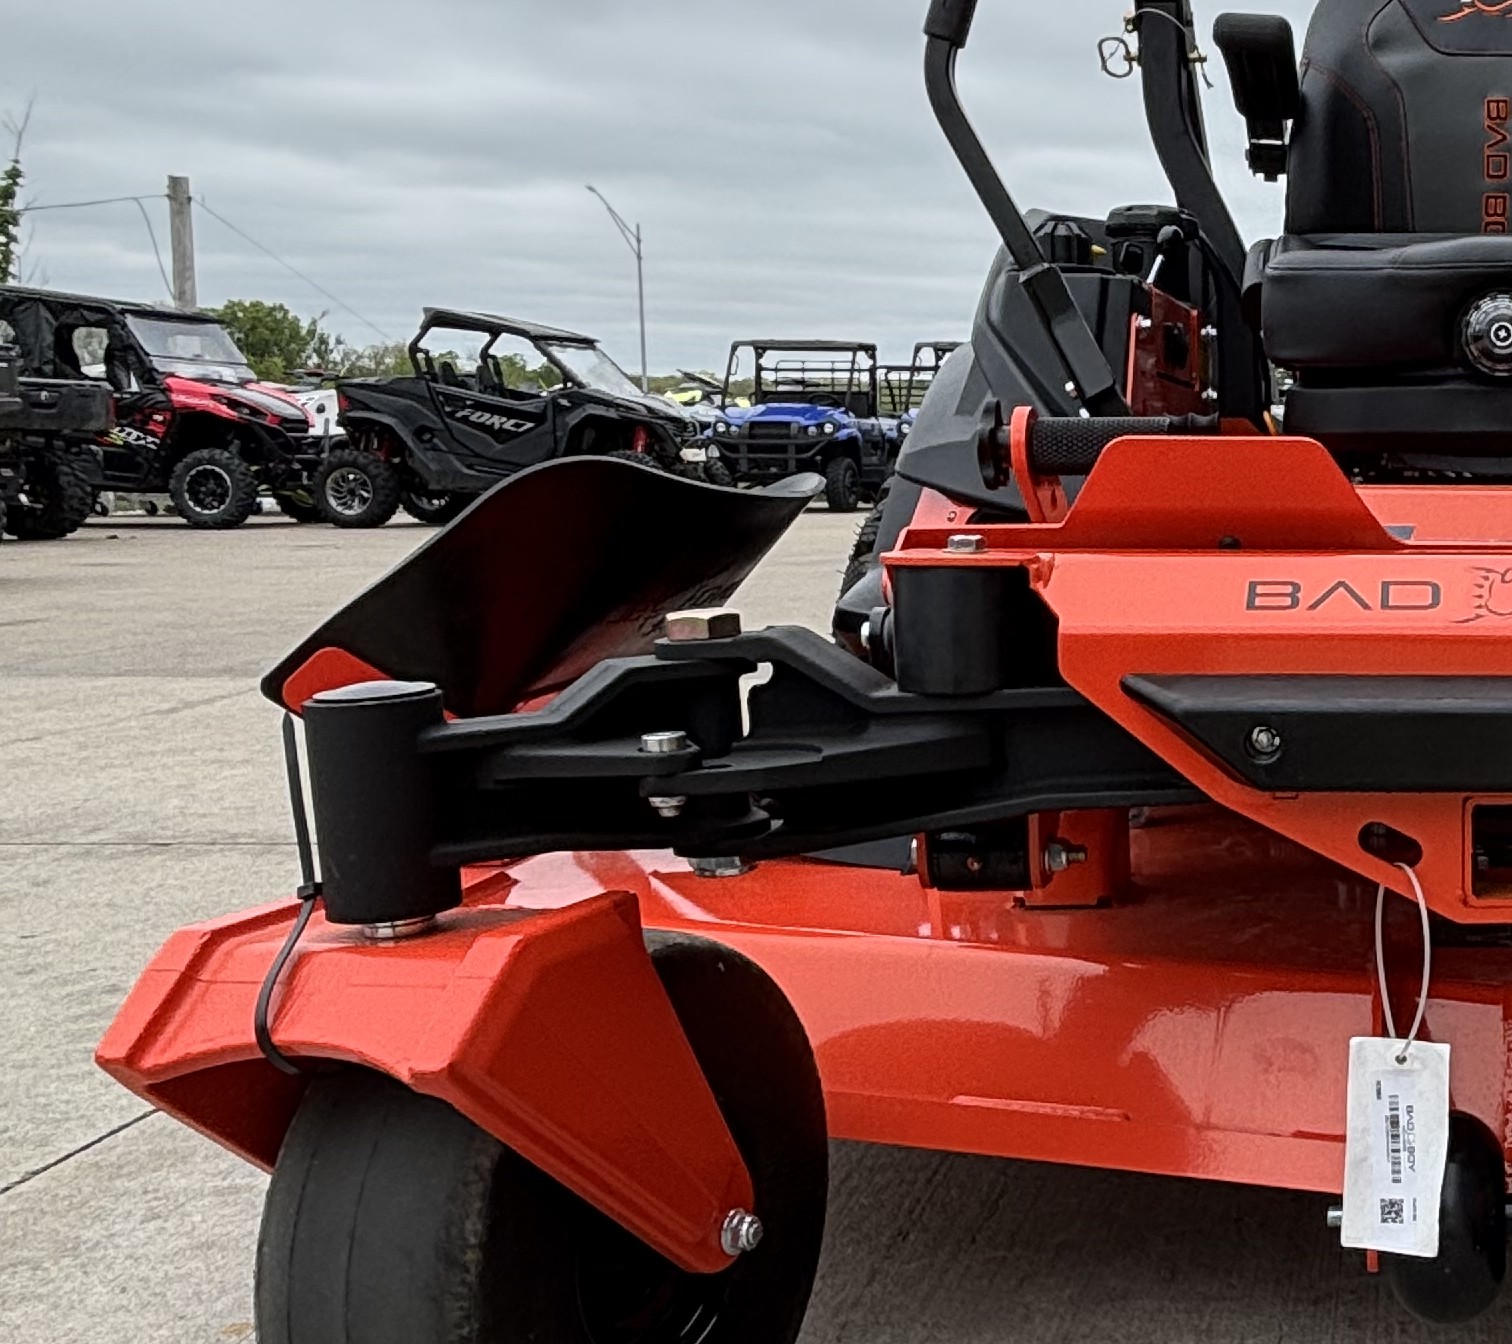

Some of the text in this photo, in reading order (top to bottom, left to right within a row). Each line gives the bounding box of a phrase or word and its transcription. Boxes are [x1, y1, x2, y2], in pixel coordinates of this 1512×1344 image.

[1483, 97, 1509, 233] BAD BO
[1245, 580, 1442, 611] BAD
[1405, 1105, 1416, 1173] BAD BOY
